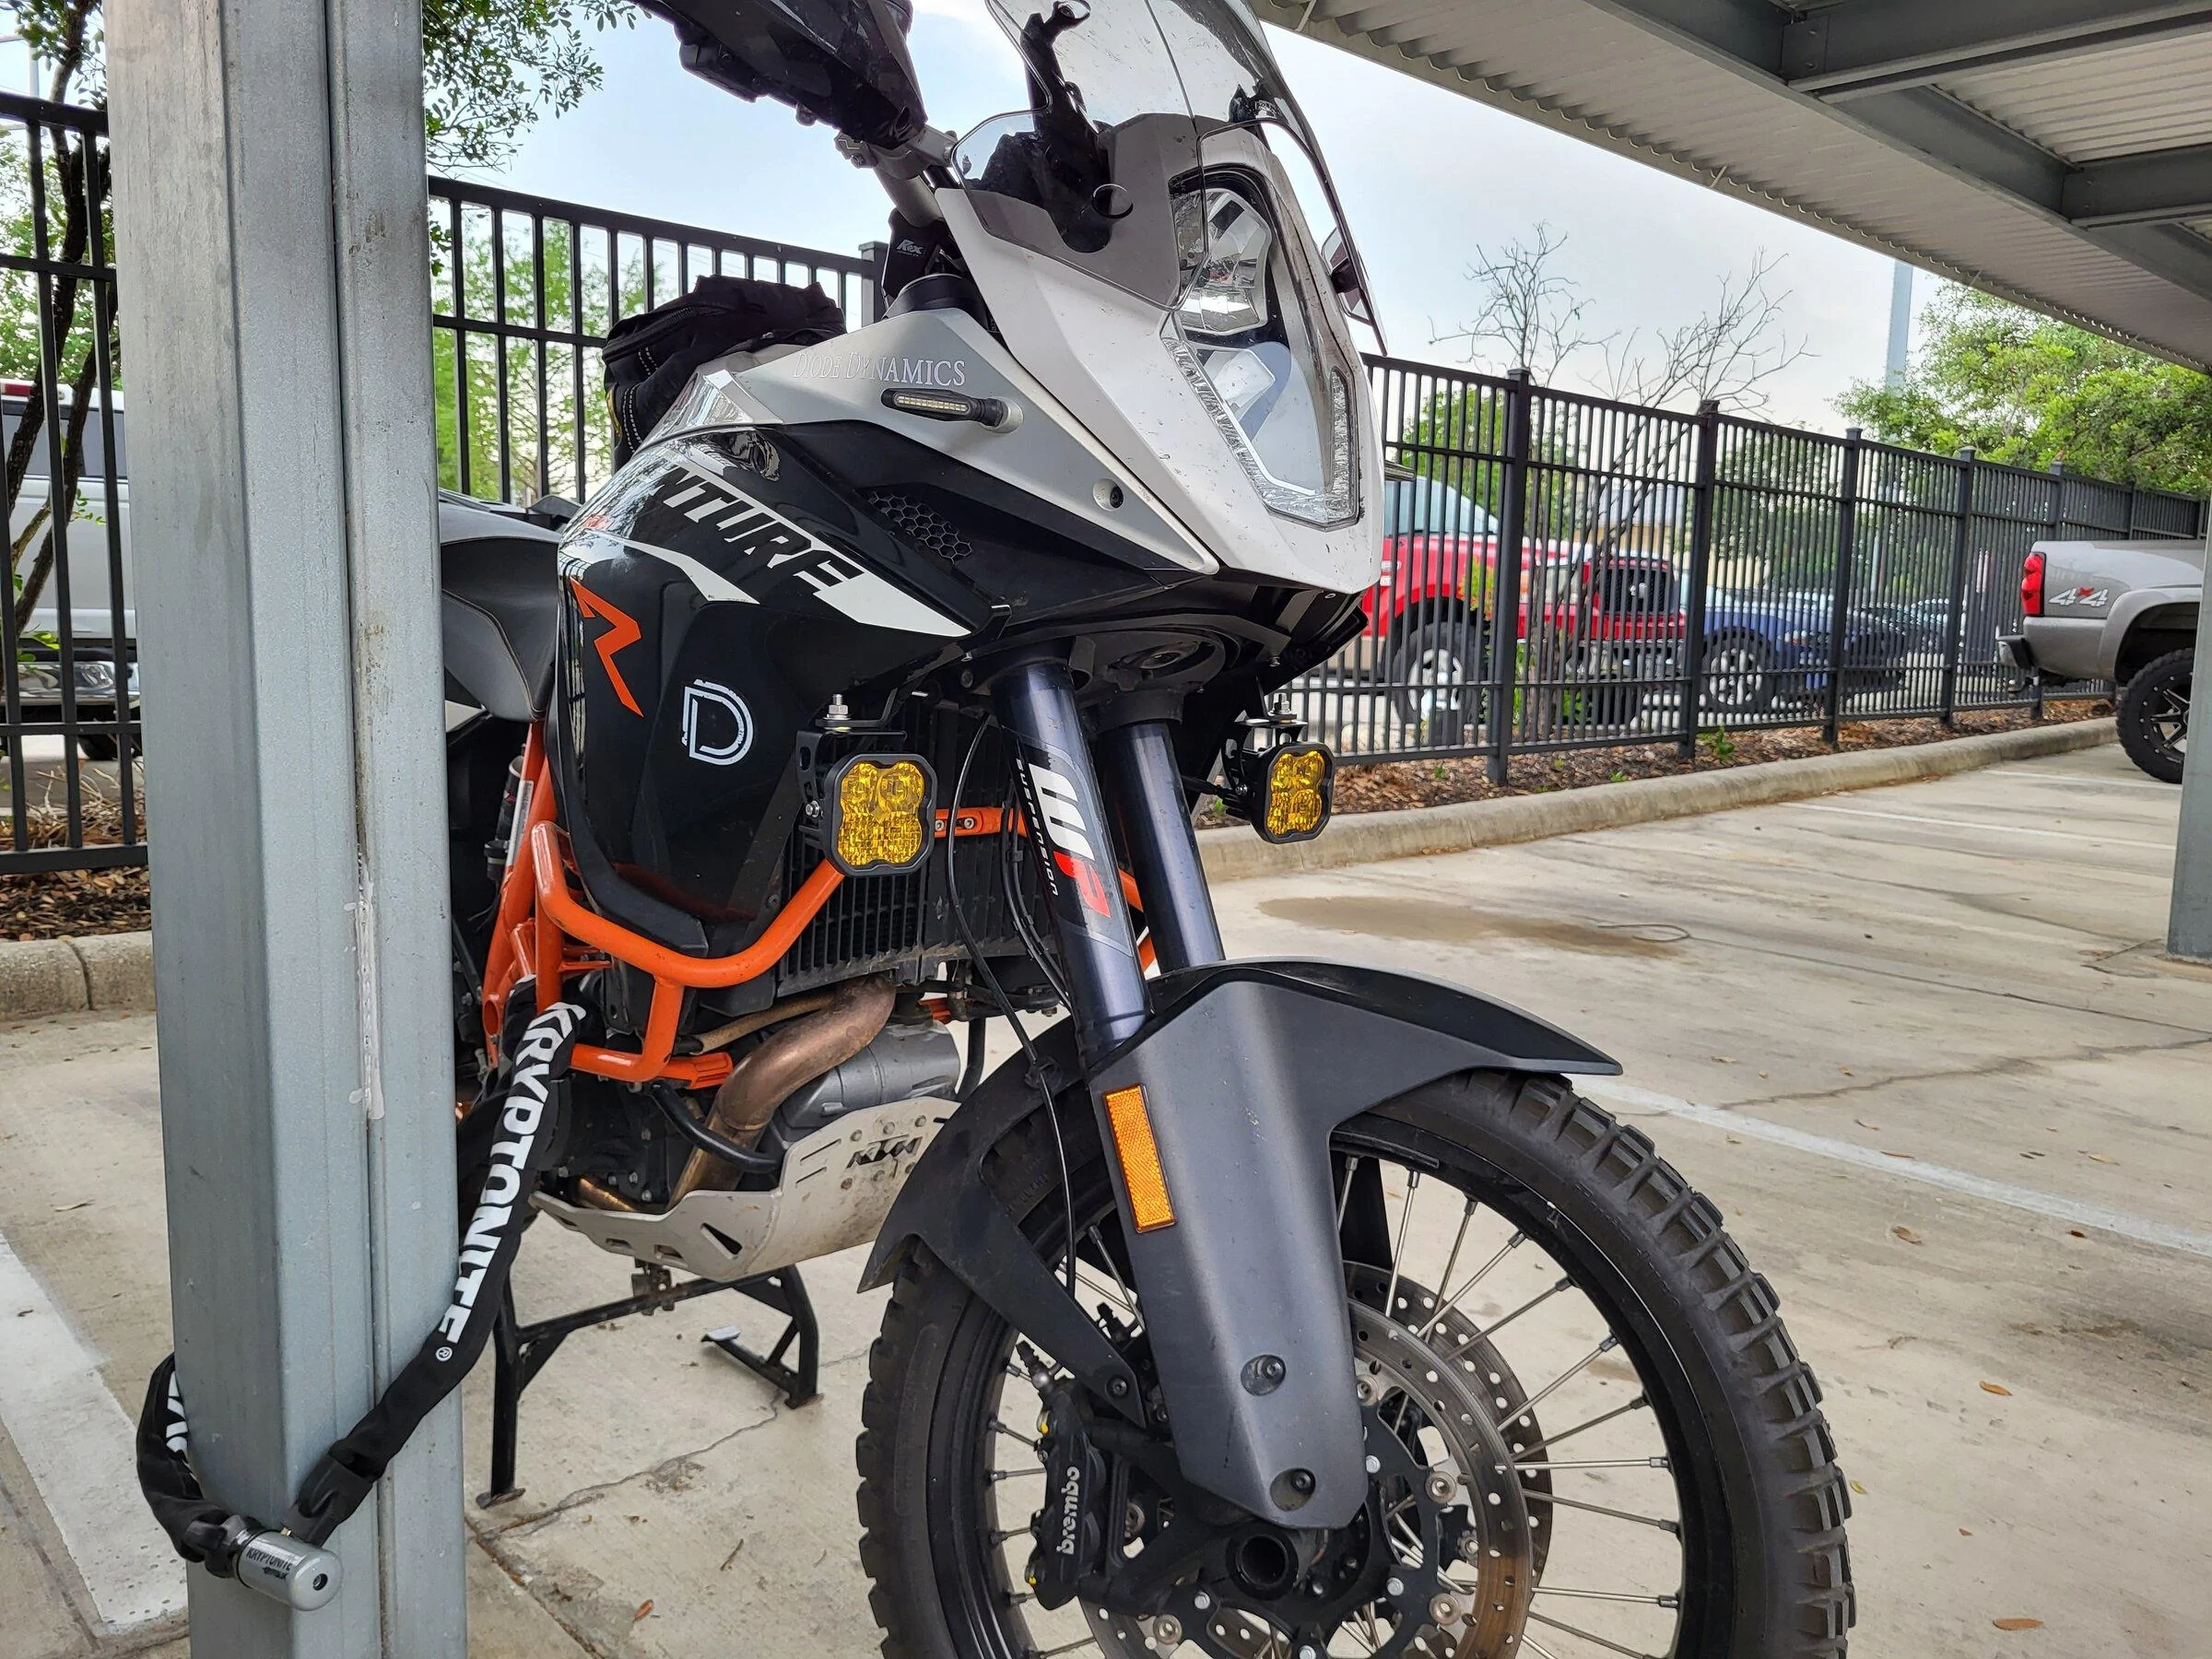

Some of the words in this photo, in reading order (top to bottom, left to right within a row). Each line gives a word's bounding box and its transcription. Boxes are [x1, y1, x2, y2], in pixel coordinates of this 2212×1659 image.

[845, 353, 966, 386] DYNAMICS
[2048, 587, 2108, 606] 4x4
[438, 1002, 587, 1345] KRYPTONITE
[1056, 1466, 1080, 1555] brembo
